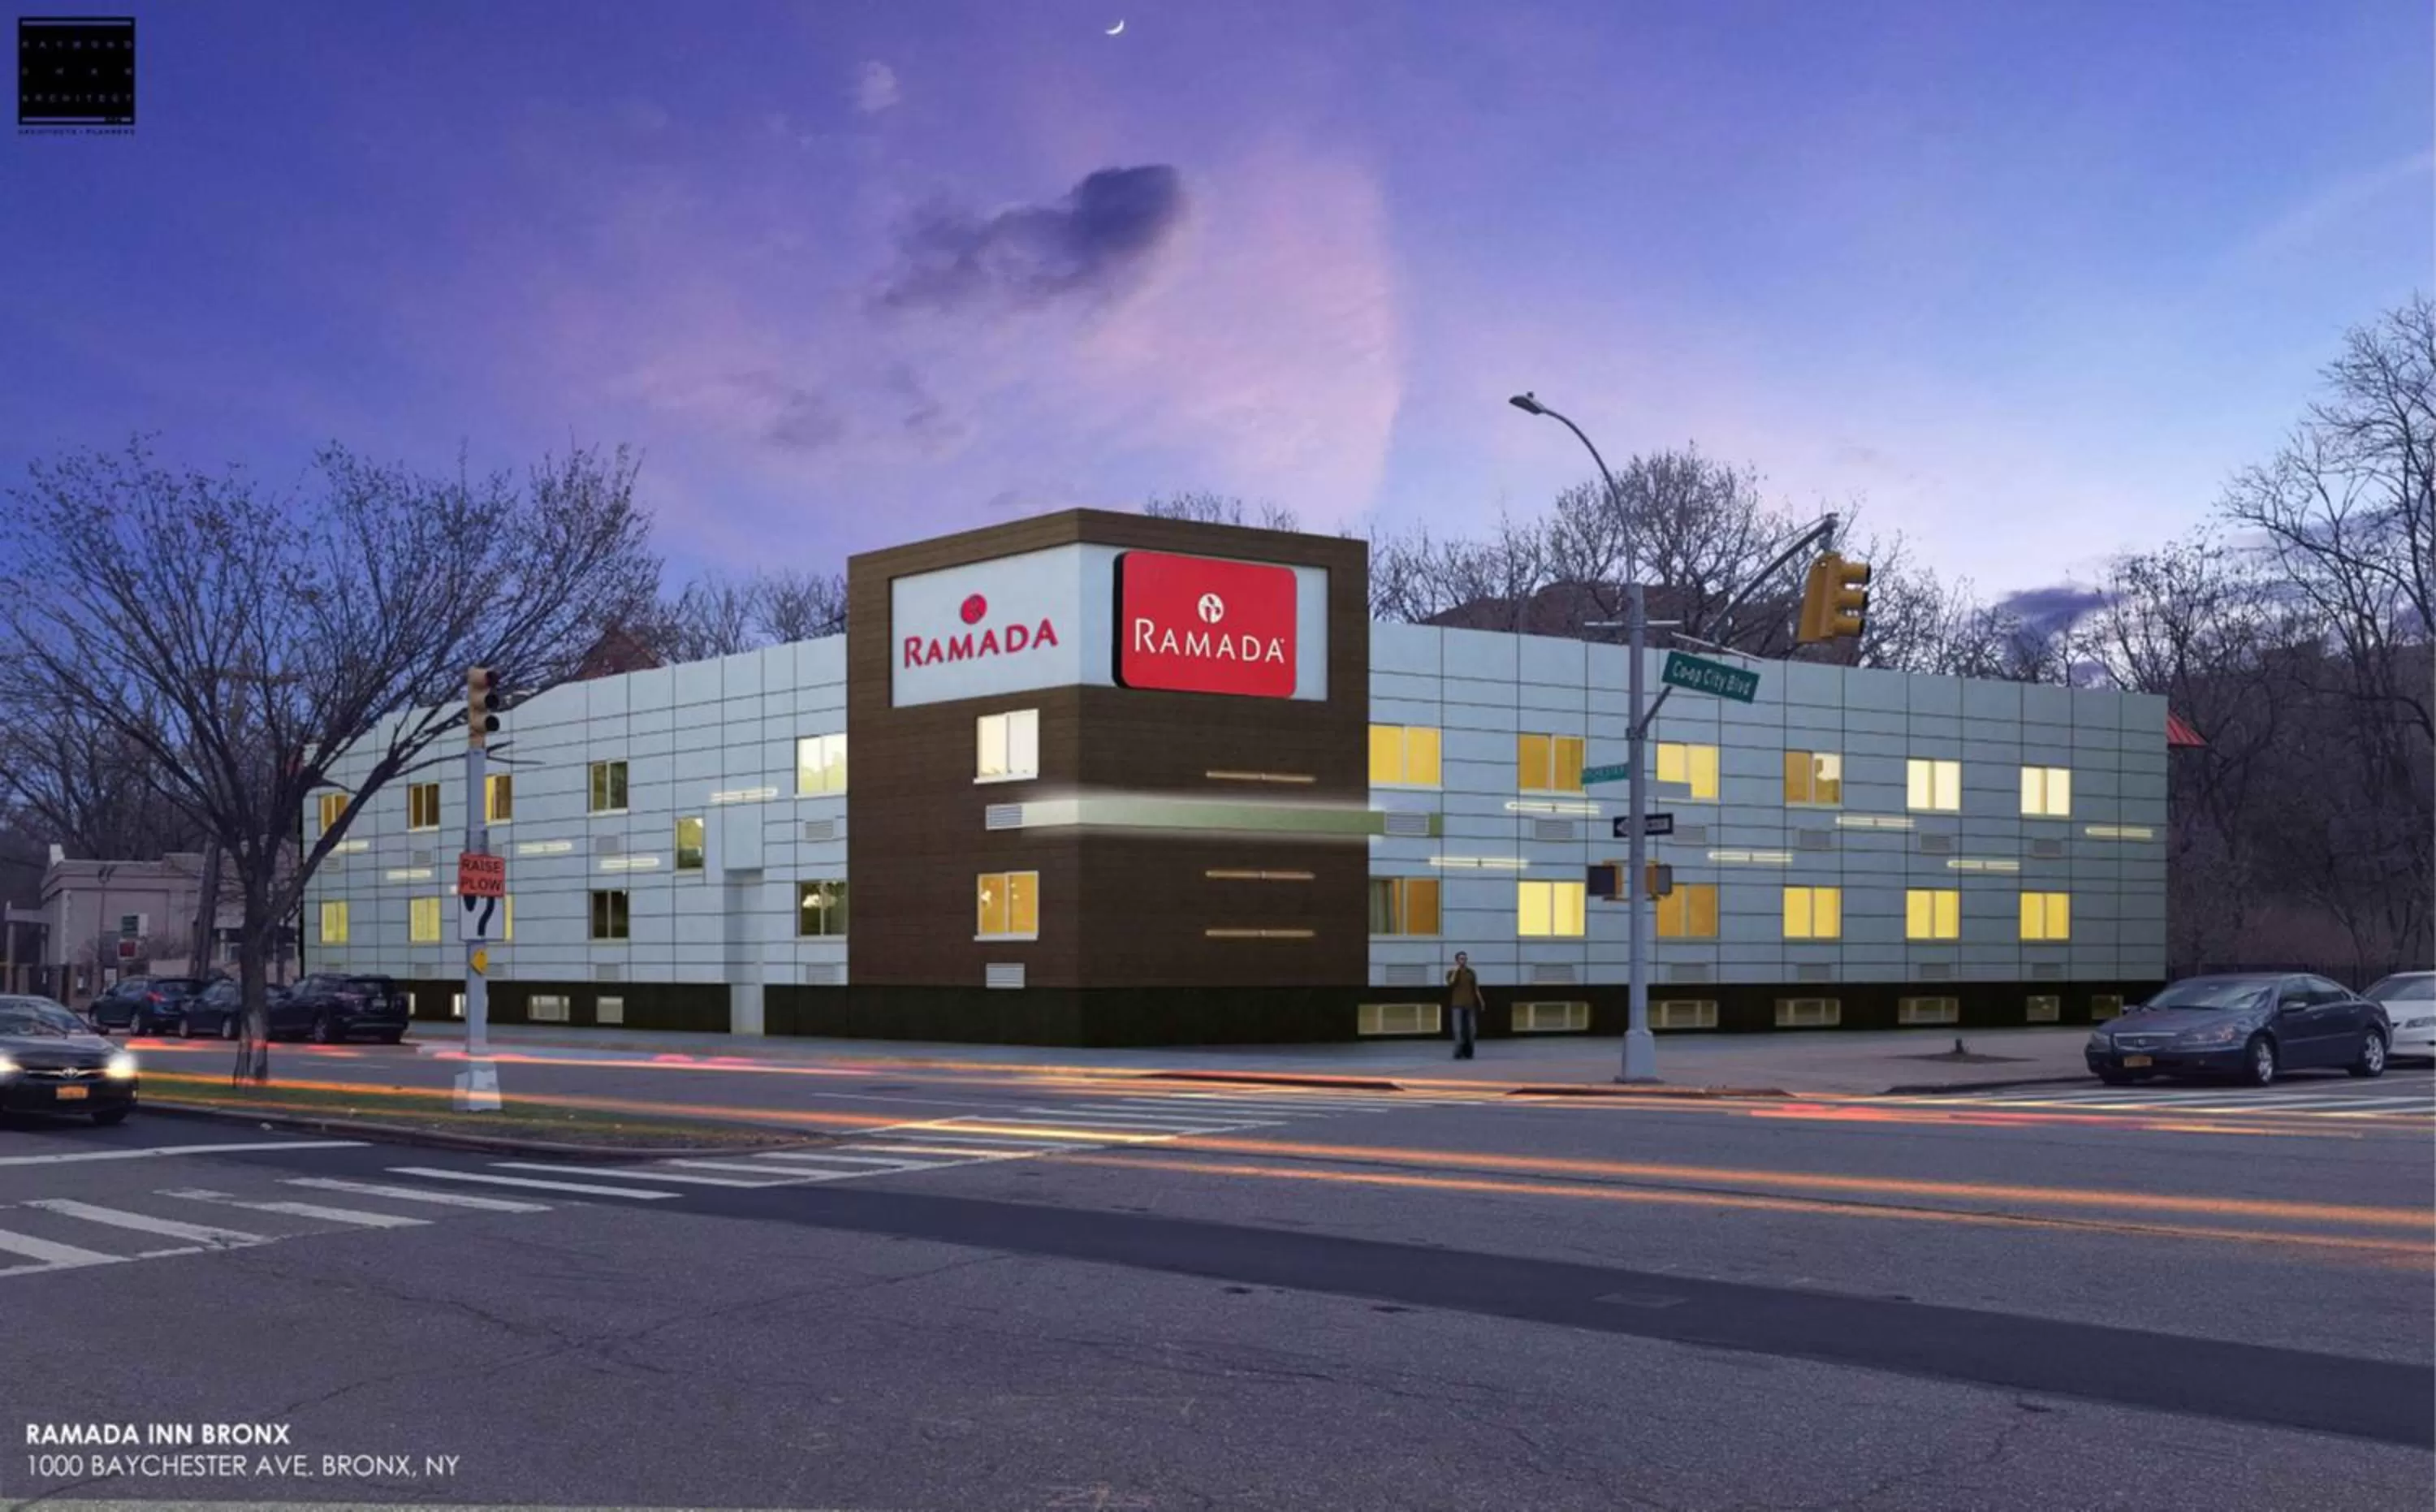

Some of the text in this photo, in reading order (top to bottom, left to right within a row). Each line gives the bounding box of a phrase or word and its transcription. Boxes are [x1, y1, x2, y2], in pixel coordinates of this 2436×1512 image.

[904, 618, 1059, 668] RAMADA
[1134, 618, 1285, 663] RAMADA
[1704, 668, 1728, 693] City
[1726, 675, 1752, 696] Blvd
[461, 858, 501, 873] RAISE
[460, 876, 503, 892] PLOW
